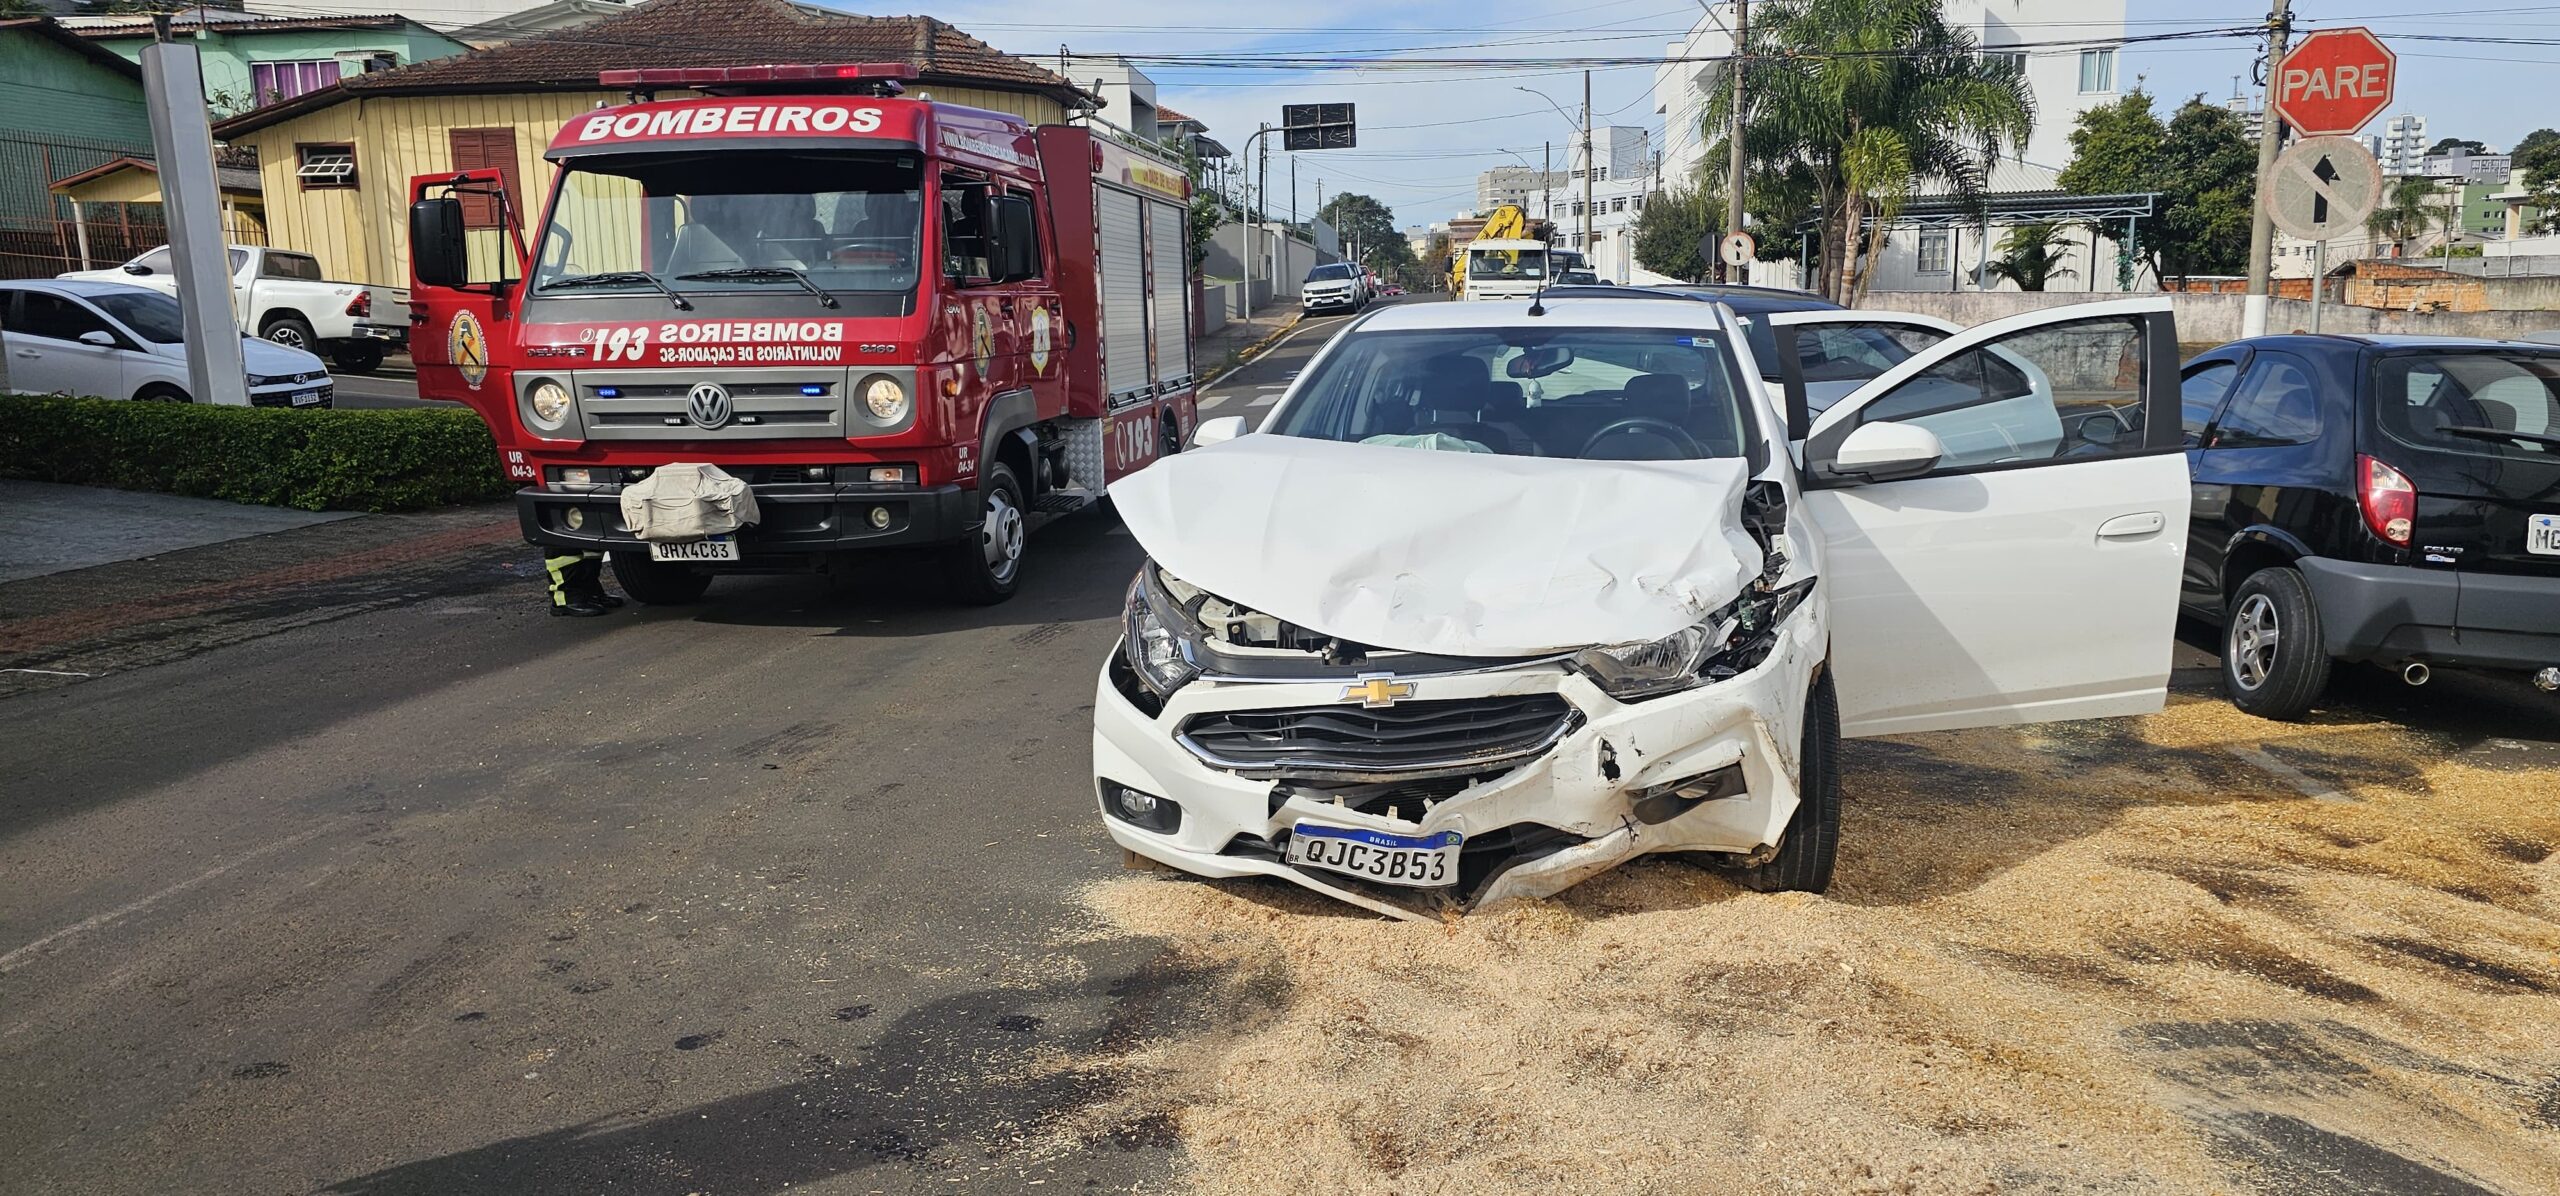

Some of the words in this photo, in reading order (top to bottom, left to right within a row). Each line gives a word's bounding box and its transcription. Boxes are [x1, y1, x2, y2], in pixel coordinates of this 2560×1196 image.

[2283, 64, 2385, 102] PARE
[579, 106, 883, 141] BOMBEIROS
[593, 326, 650, 362] 193
[1127, 415, 1153, 463] 193
[508, 451, 524, 463] UR
[959, 446, 968, 459] UR
[659, 542, 729, 559] QHX4C83
[1369, 836, 1397, 847] BRASIL
[1289, 853, 1300, 863] BR
[1305, 840, 1446, 881] QJC3B53
